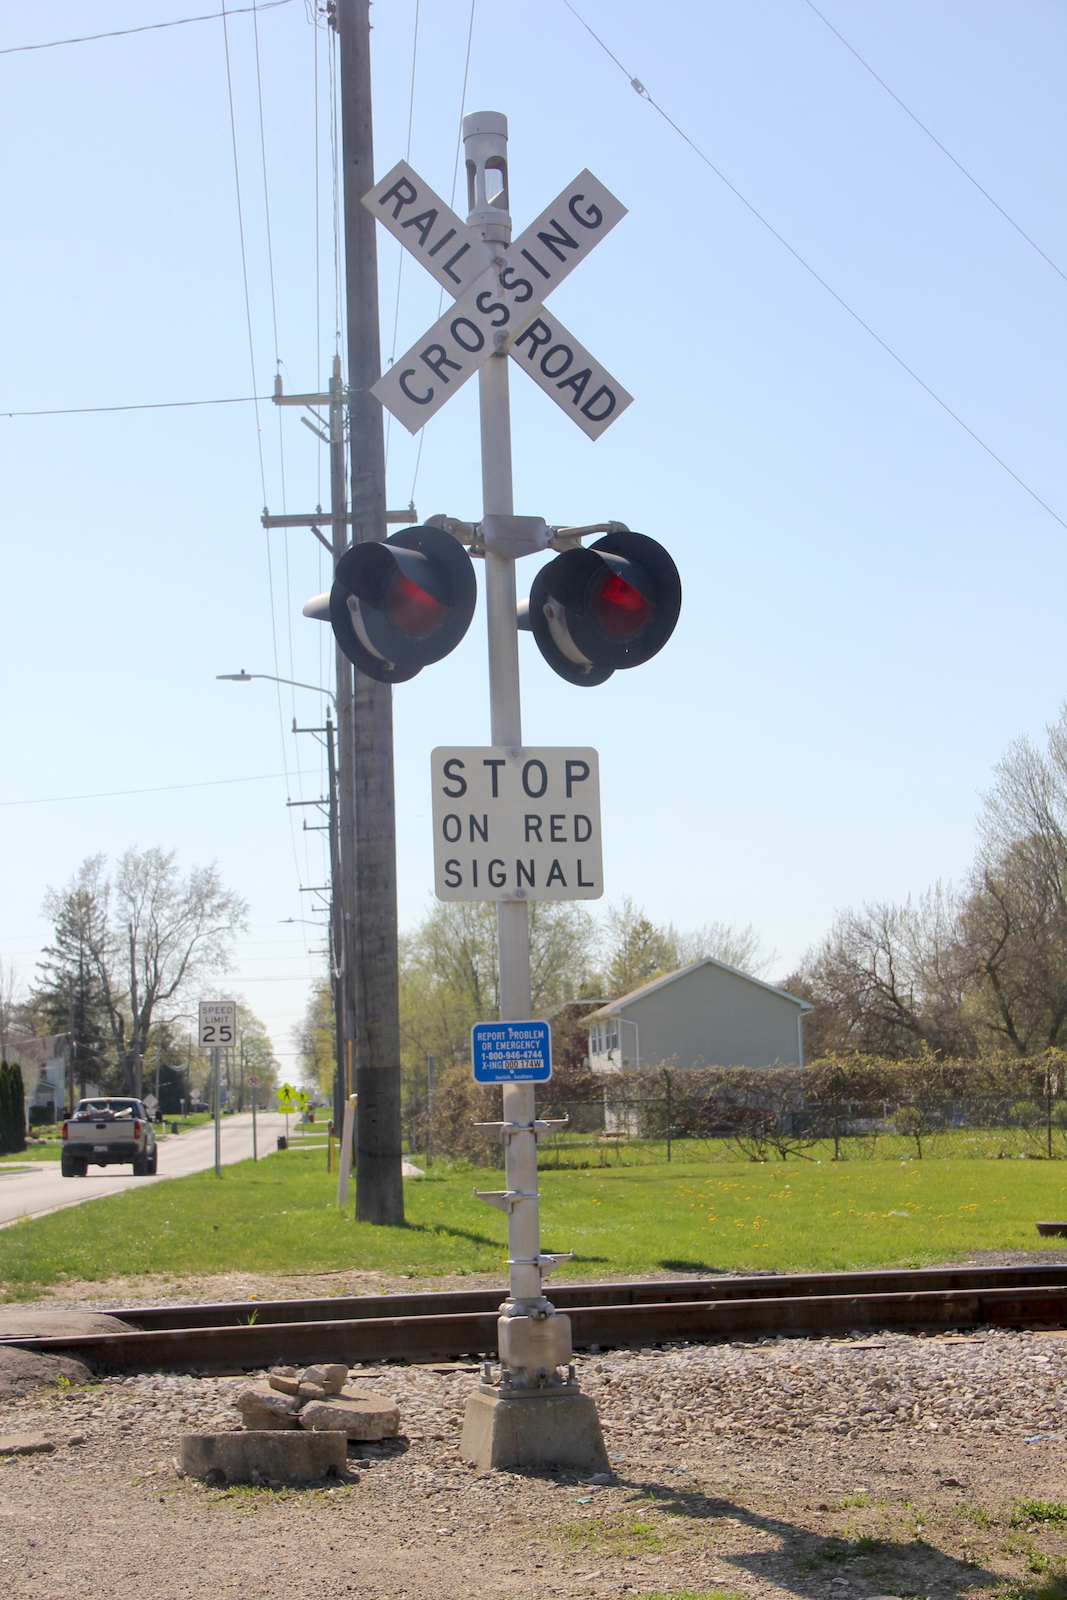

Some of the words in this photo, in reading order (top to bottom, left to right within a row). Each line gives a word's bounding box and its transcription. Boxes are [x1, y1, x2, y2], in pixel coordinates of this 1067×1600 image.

[378, 176, 471, 285] RAIL
[398, 194, 603, 405] CROSSING
[514, 317, 617, 422] ROAD
[442, 758, 590, 799] STOP
[442, 813, 489, 843] ON
[524, 814, 593, 843] RED
[444, 858, 594, 888] SIGNAL
[202, 1006, 233, 1015] SPEED
[205, 1016, 229, 1024] LIMIT
[202, 1025, 232, 1042] 25
[477, 1031, 506, 1041] REPORT
[509, 1030, 544, 1040] PROBLEM
[481, 1041, 492, 1051] OR
[495, 1040, 541, 1050] EMERGENCY
[481, 1050, 543, 1061] 1-800-946-4744
[482, 1061, 503, 1070] X-ING
[504, 1061, 519, 1069] 000
[521, 1060, 542, 1068] 174W
